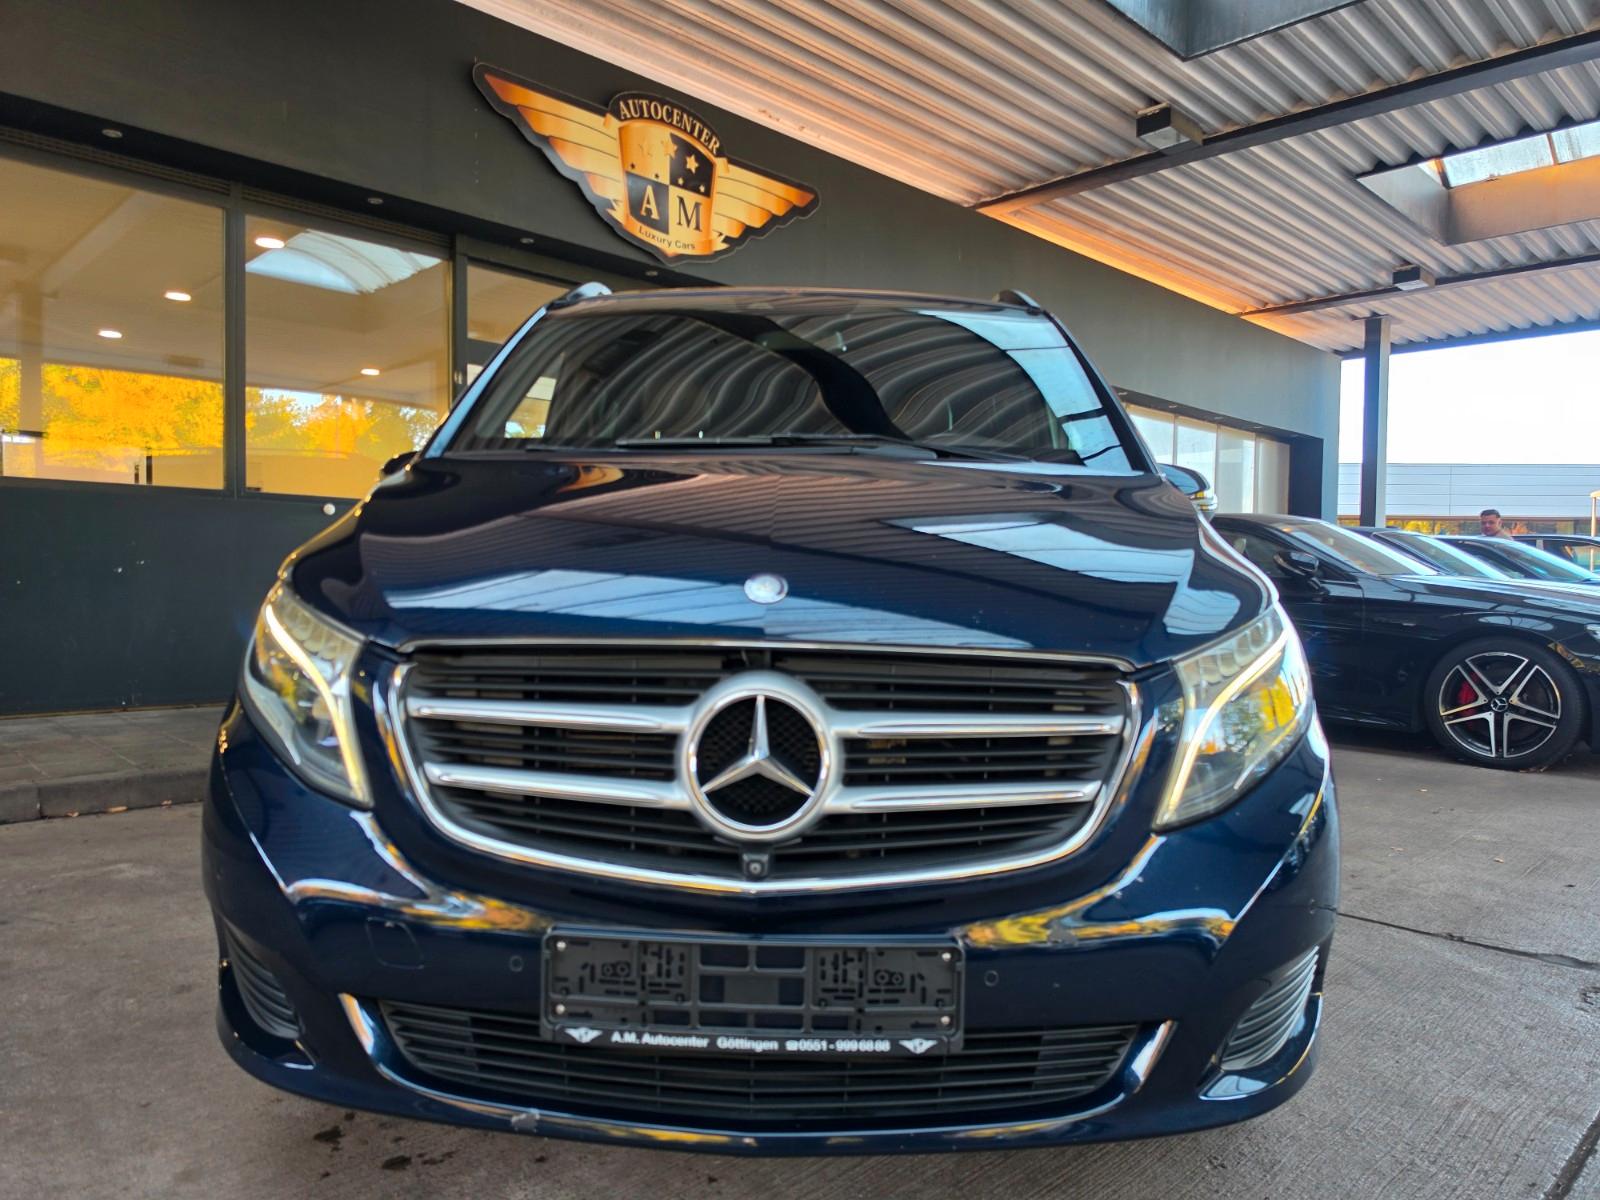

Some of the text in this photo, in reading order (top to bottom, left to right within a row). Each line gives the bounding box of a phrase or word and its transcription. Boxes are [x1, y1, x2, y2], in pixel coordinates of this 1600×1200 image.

[619, 99, 720, 155] AUTOCENTER
[640, 184, 703, 233] A M
[638, 225, 696, 251] Luxury Cars
[611, 1031, 640, 1045] A.M.
[641, 1032, 710, 1048] Autocenter
[716, 1036, 779, 1053] Göttingen
